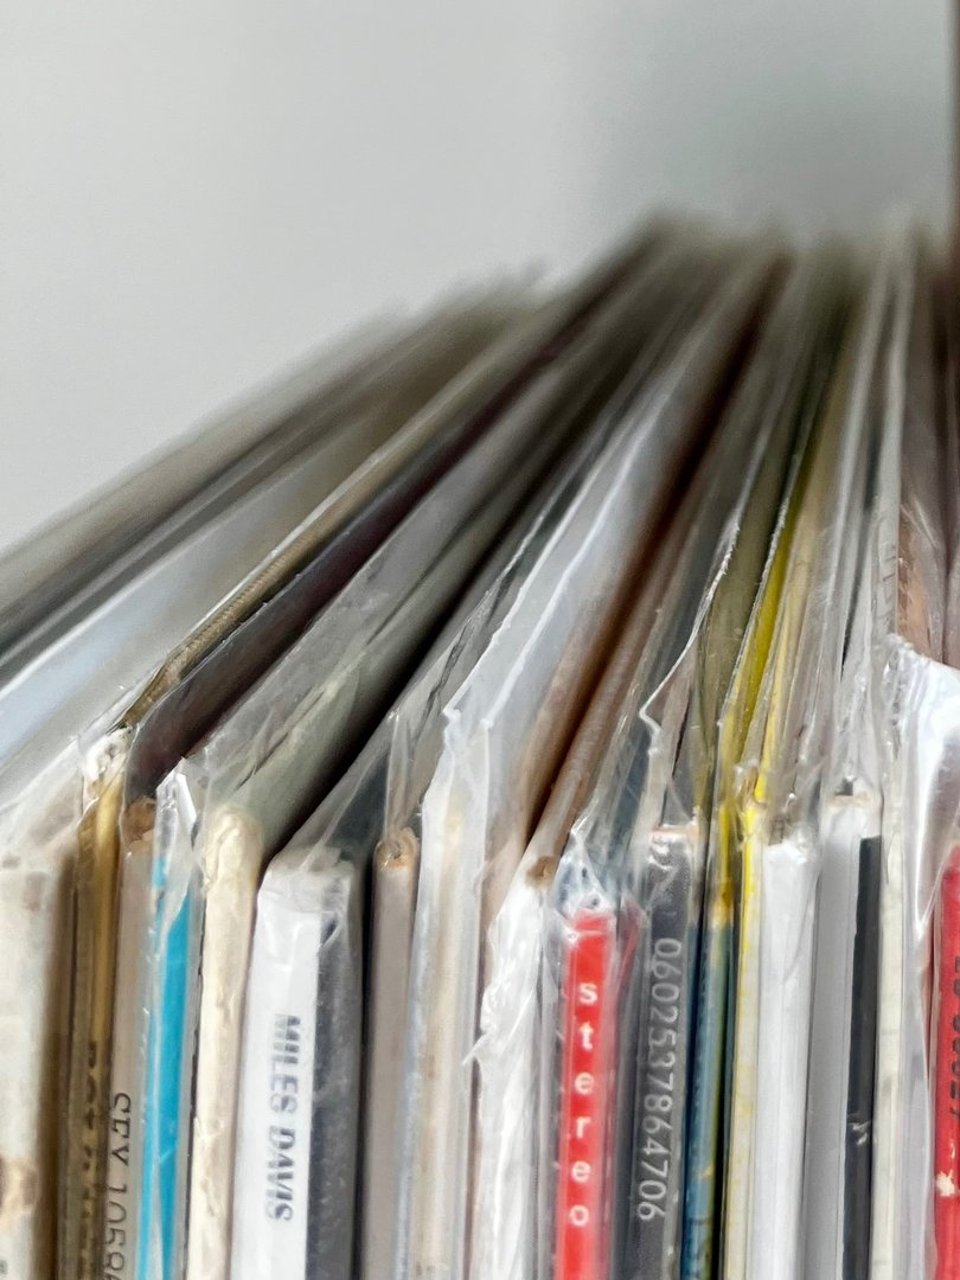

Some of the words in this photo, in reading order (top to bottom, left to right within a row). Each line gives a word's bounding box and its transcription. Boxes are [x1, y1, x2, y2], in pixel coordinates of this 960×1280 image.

[270, 1014, 301, 1114] MILES
[569, 983, 598, 1226] stereo
[638, 938, 681, 1221] 0602537864706
[266, 1125, 296, 1222] DAVIS
